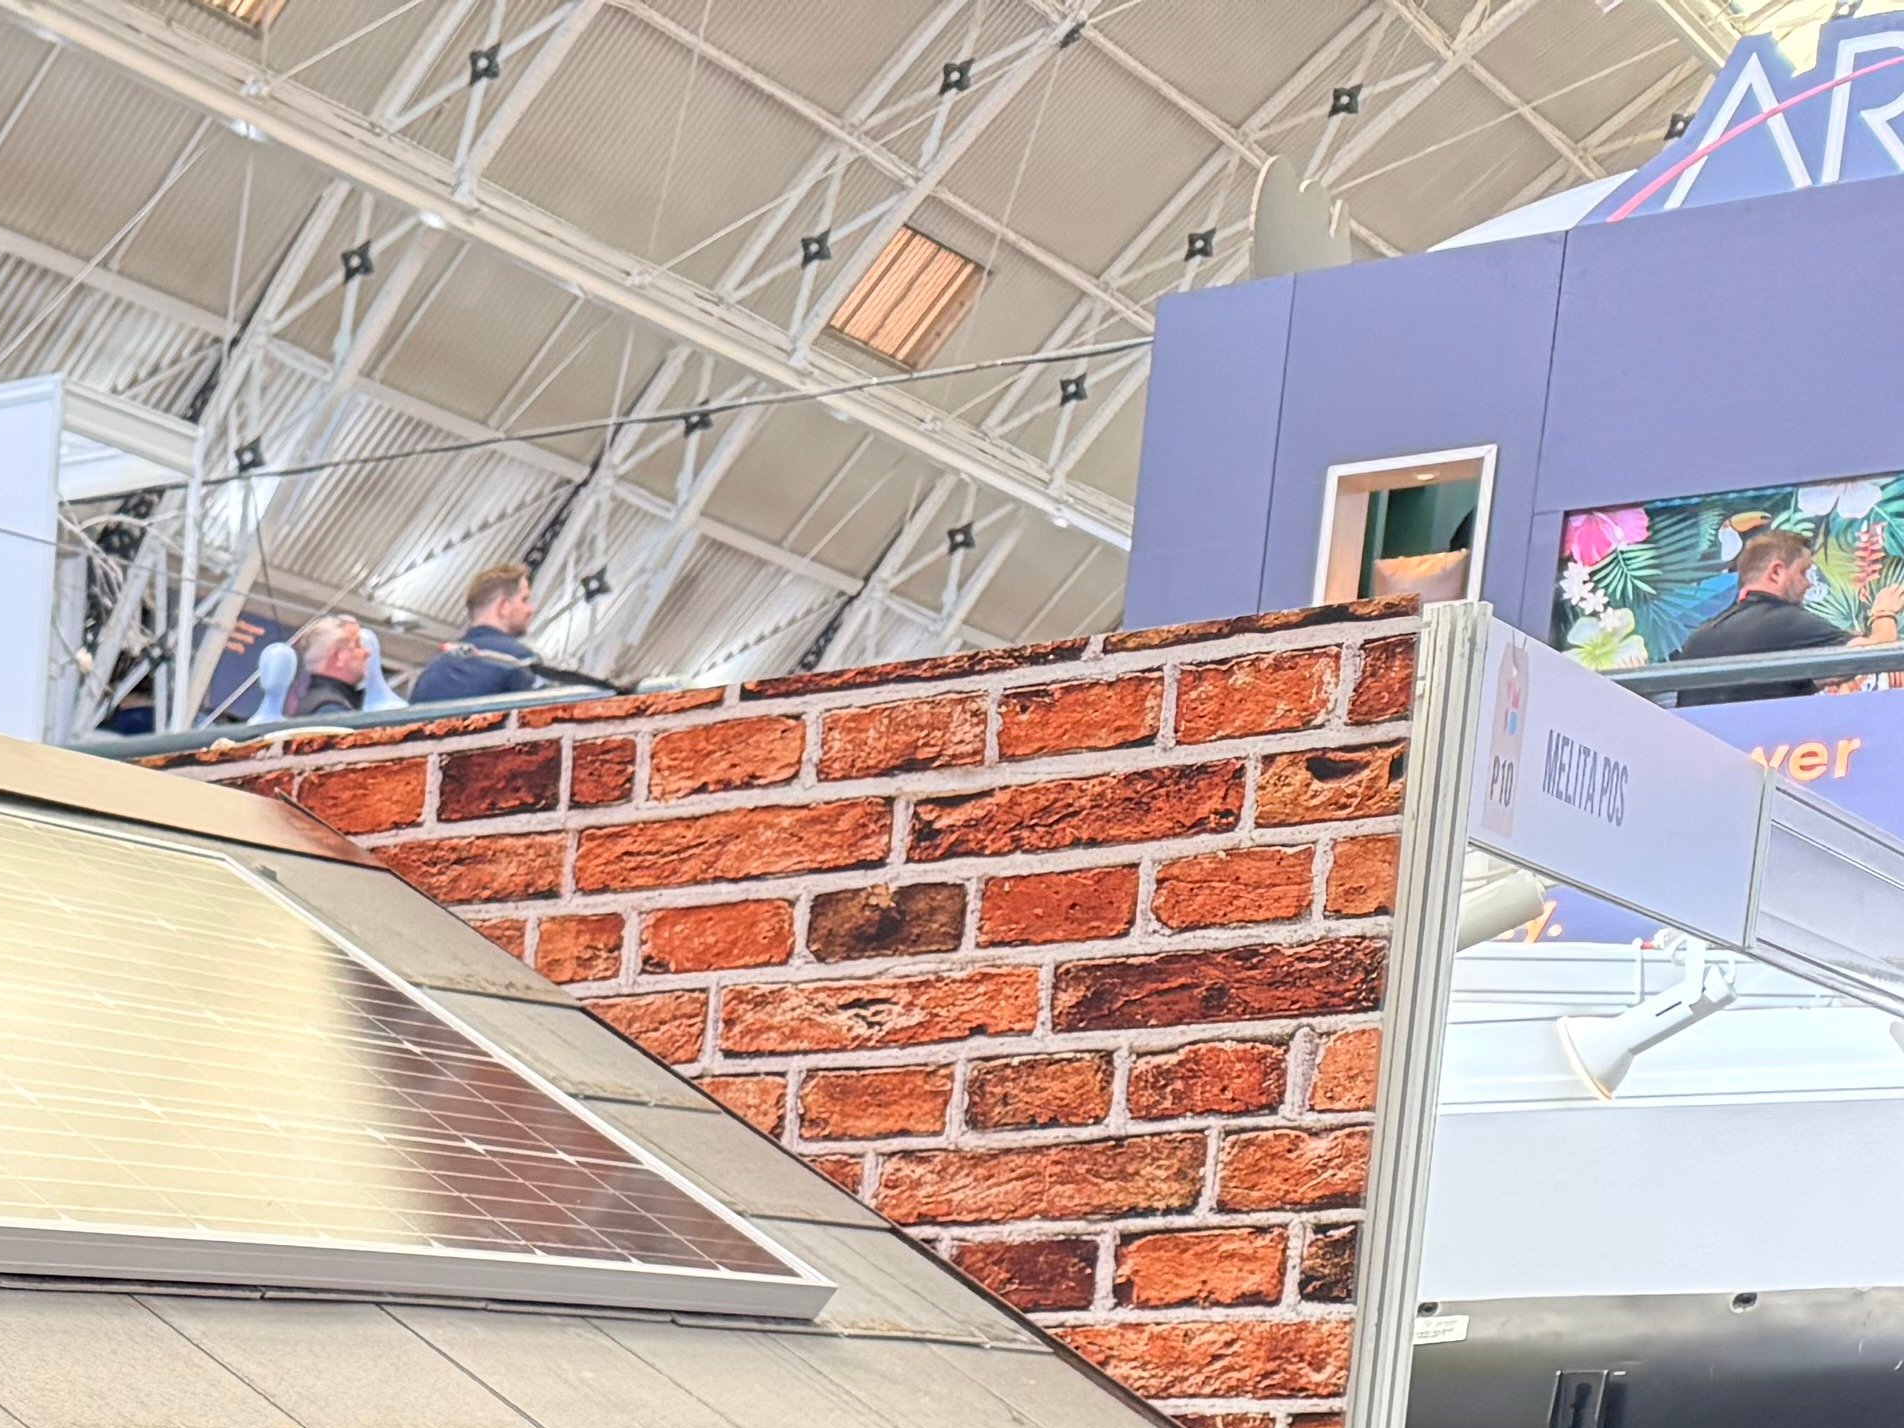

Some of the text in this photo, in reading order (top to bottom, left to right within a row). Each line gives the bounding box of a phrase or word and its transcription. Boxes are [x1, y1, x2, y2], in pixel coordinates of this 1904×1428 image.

[1490, 754, 1514, 808] P10
[1542, 728, 1629, 828] MELITA POS
